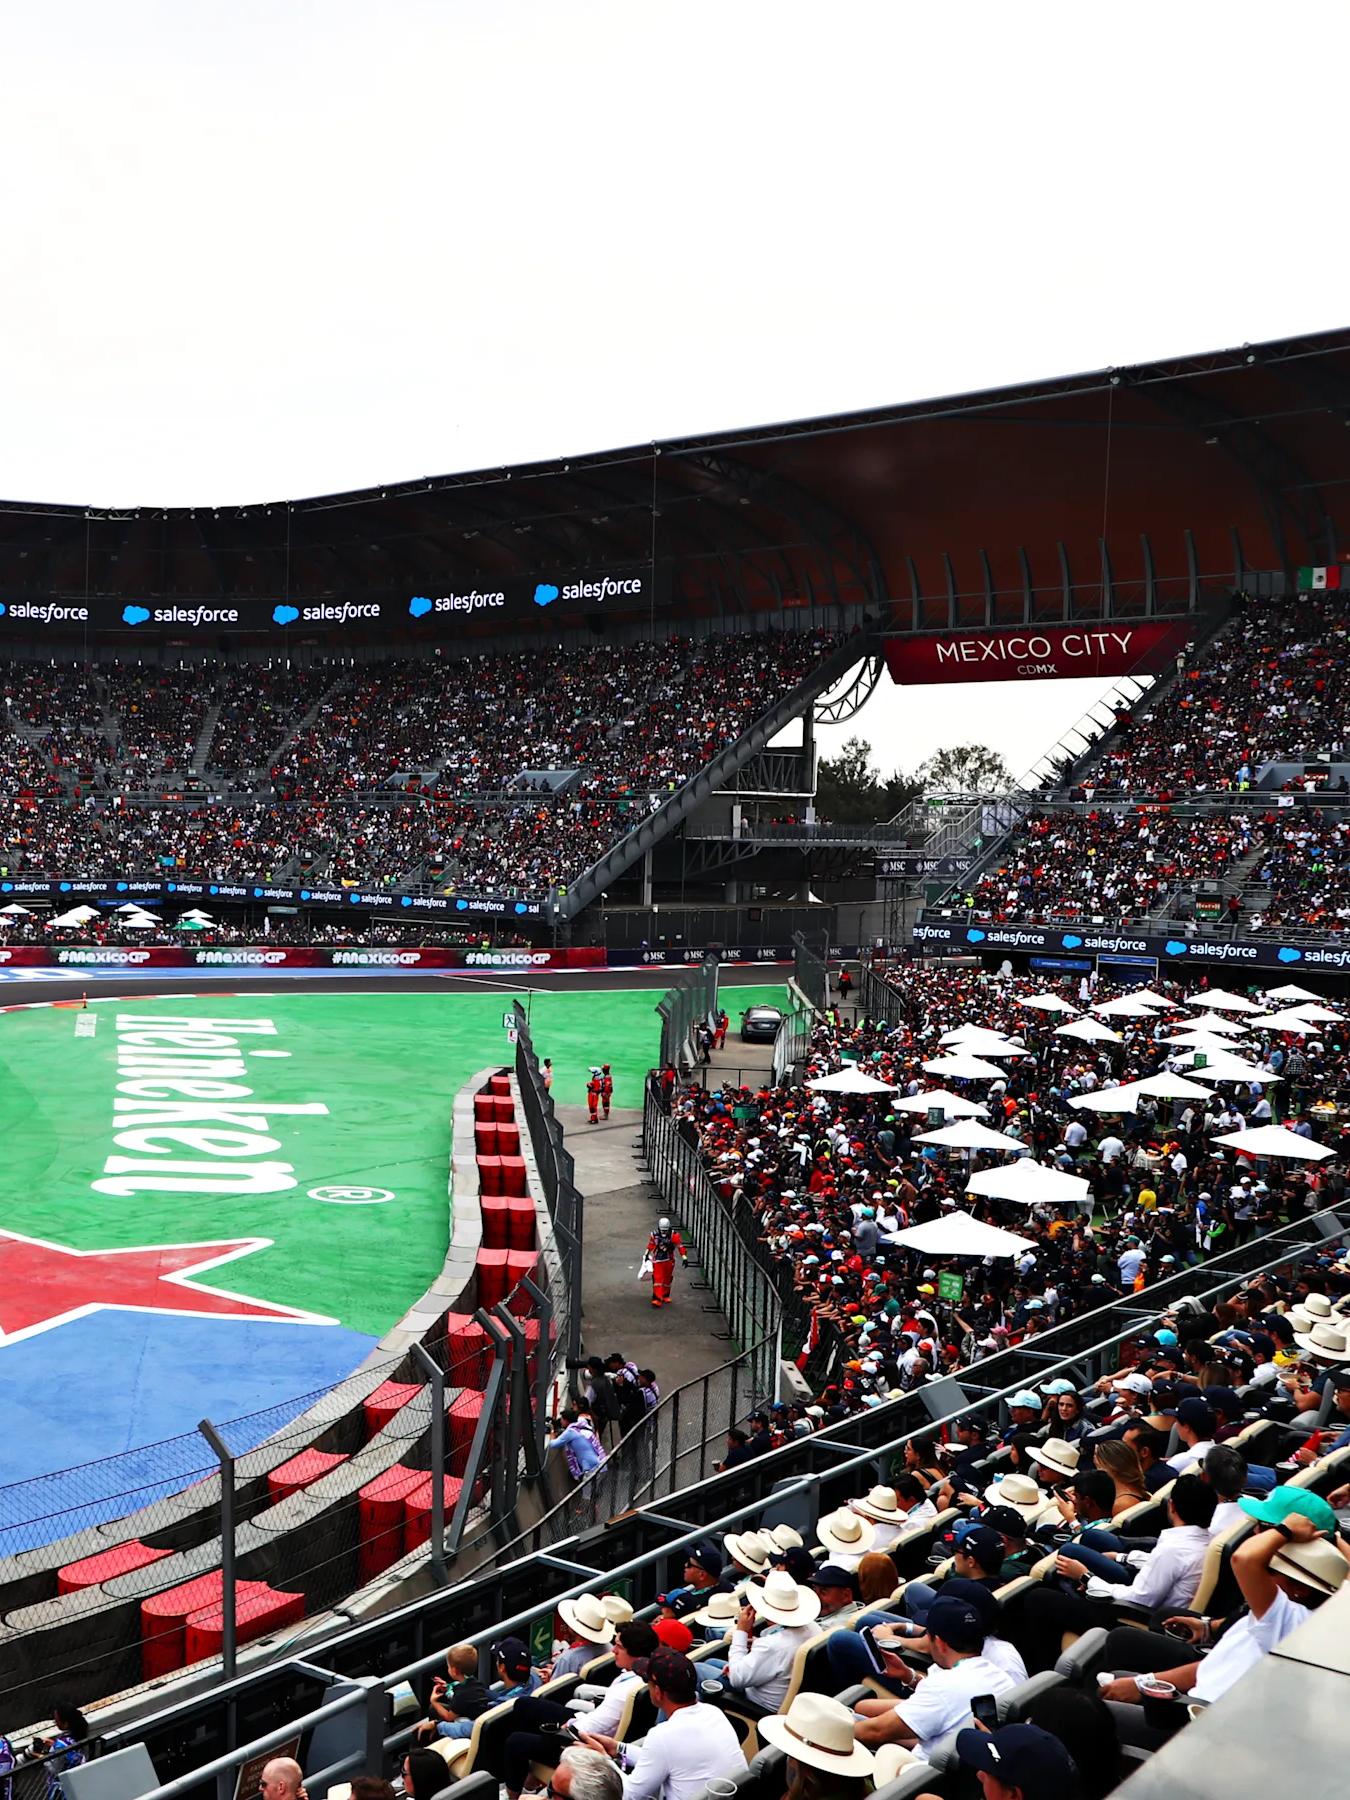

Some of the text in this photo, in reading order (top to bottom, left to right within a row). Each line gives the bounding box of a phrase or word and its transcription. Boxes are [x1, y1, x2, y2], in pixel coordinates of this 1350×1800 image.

[563, 577, 641, 601] salesforce
[436, 591, 504, 613] salesforce
[10, 602, 88, 622] salesforce
[155, 606, 238, 625] salesforce
[303, 602, 380, 622] salesforce
[936, 632, 1132, 663] MEXICO CITY
[1017, 664, 1057, 675] CDMX
[890, 861, 906, 871] MSC
[924, 861, 939, 870] MSC
[15, 880, 49, 892] salesforce
[71, 880, 107, 892] salesforce
[129, 882, 160, 891] salesforce
[177, 884, 202, 893] salesforce
[220, 886, 246, 896] salesforce
[265, 889, 292, 898] salesforce
[310, 889, 341, 902] salesforce
[362, 894, 392, 905] salesforce
[414, 897, 446, 908] salesforce
[469, 901, 504, 912] salesforce
[988, 931, 1044, 945] salesforce
[1085, 937, 1146, 951] salesforce
[1190, 940, 1256, 958] salesforce
[59, 951, 150, 963] #MexicoGP
[196, 951, 286, 963] #MexicoGP
[332, 952, 420, 963] #MexicoGP
[466, 953, 550, 964] #MexicoGP
[649, 951, 666, 960] MSC
[690, 950, 704, 959] MSC
[728, 950, 741, 958] MSC
[763, 949, 777, 957] MSC
